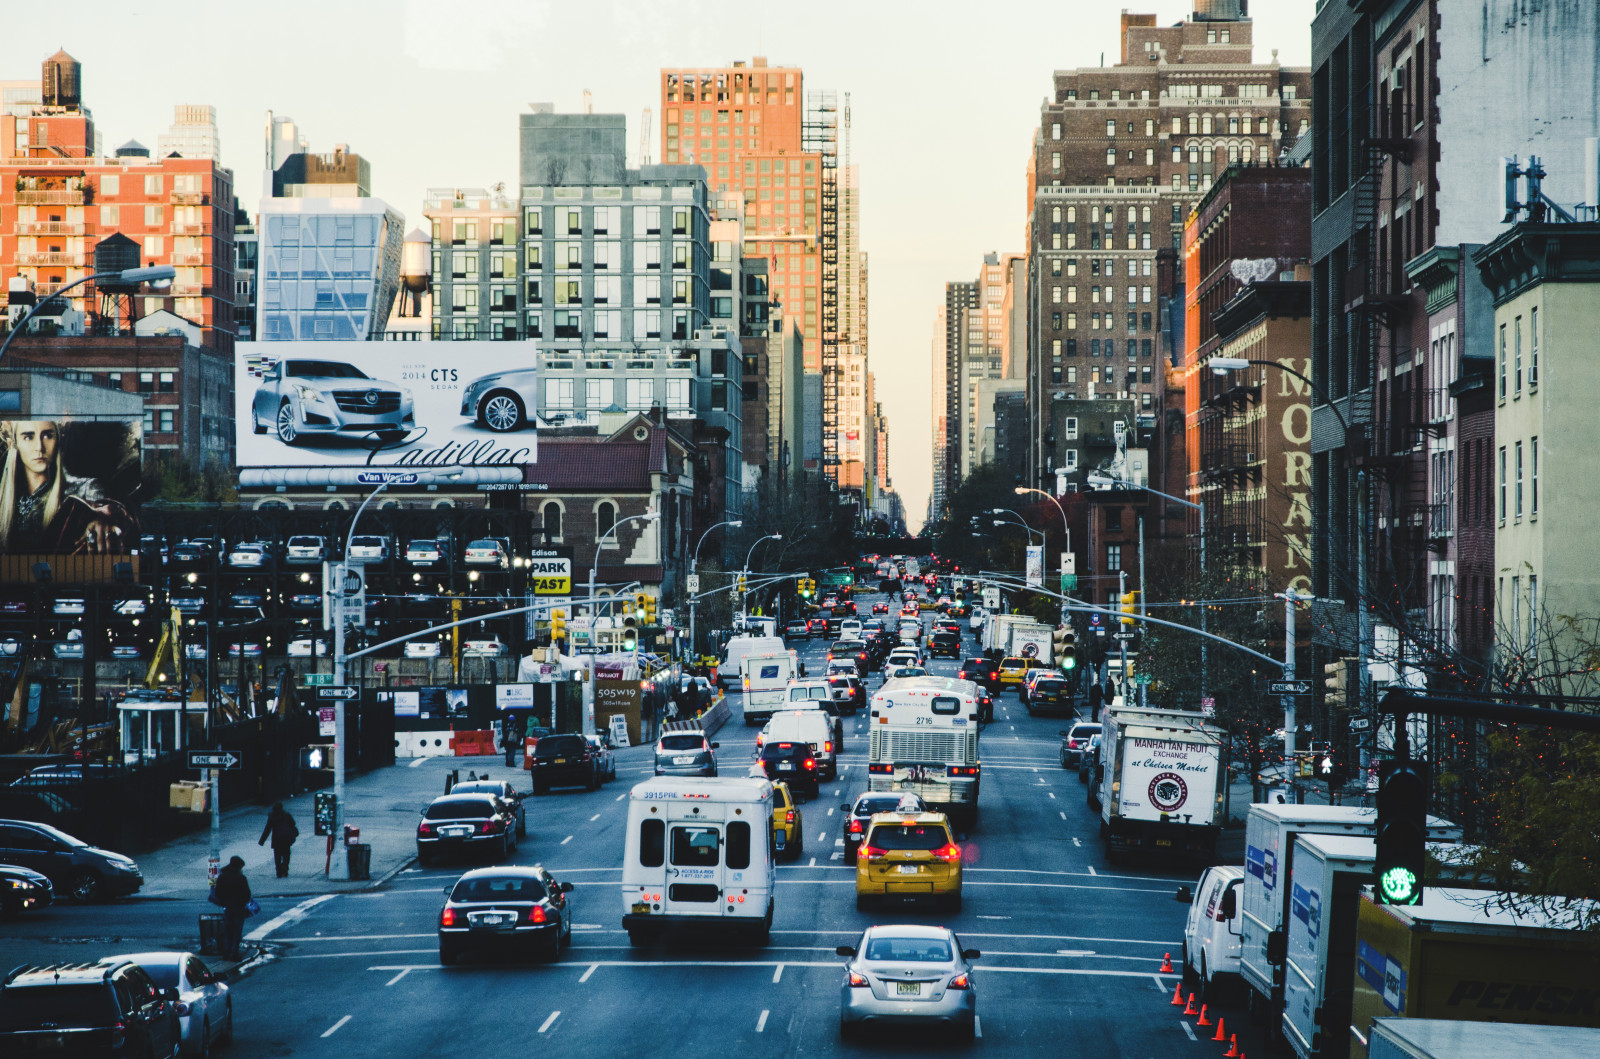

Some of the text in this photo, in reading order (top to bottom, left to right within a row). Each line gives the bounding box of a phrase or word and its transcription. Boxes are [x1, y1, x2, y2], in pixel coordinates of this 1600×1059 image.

[402, 372, 426, 380] 2014
[430, 368, 459, 382] CTS
[361, 427, 530, 465] Cadillac
[364, 472, 415, 484] Van Wagner
[532, 562, 566, 573] PARK
[534, 578, 566, 590] FAST
[306, 675, 313, 684] W
[316, 675, 325, 684] 18
[598, 688, 636, 698] 505W19
[1134, 738, 1208, 754] MANHATTAN FRUIT
[195, 756, 233, 764] ONE WAY
[1153, 752, 1188, 760] EXCHANGE
[1143, 758, 1173, 770] Chelsea
[1176, 762, 1208, 773] Market
[1149, 773, 1186, 797] CHELSEA MARKET
[643, 791, 678, 799] 3915PRE
[1446, 980, 1600, 1016] PENSK
